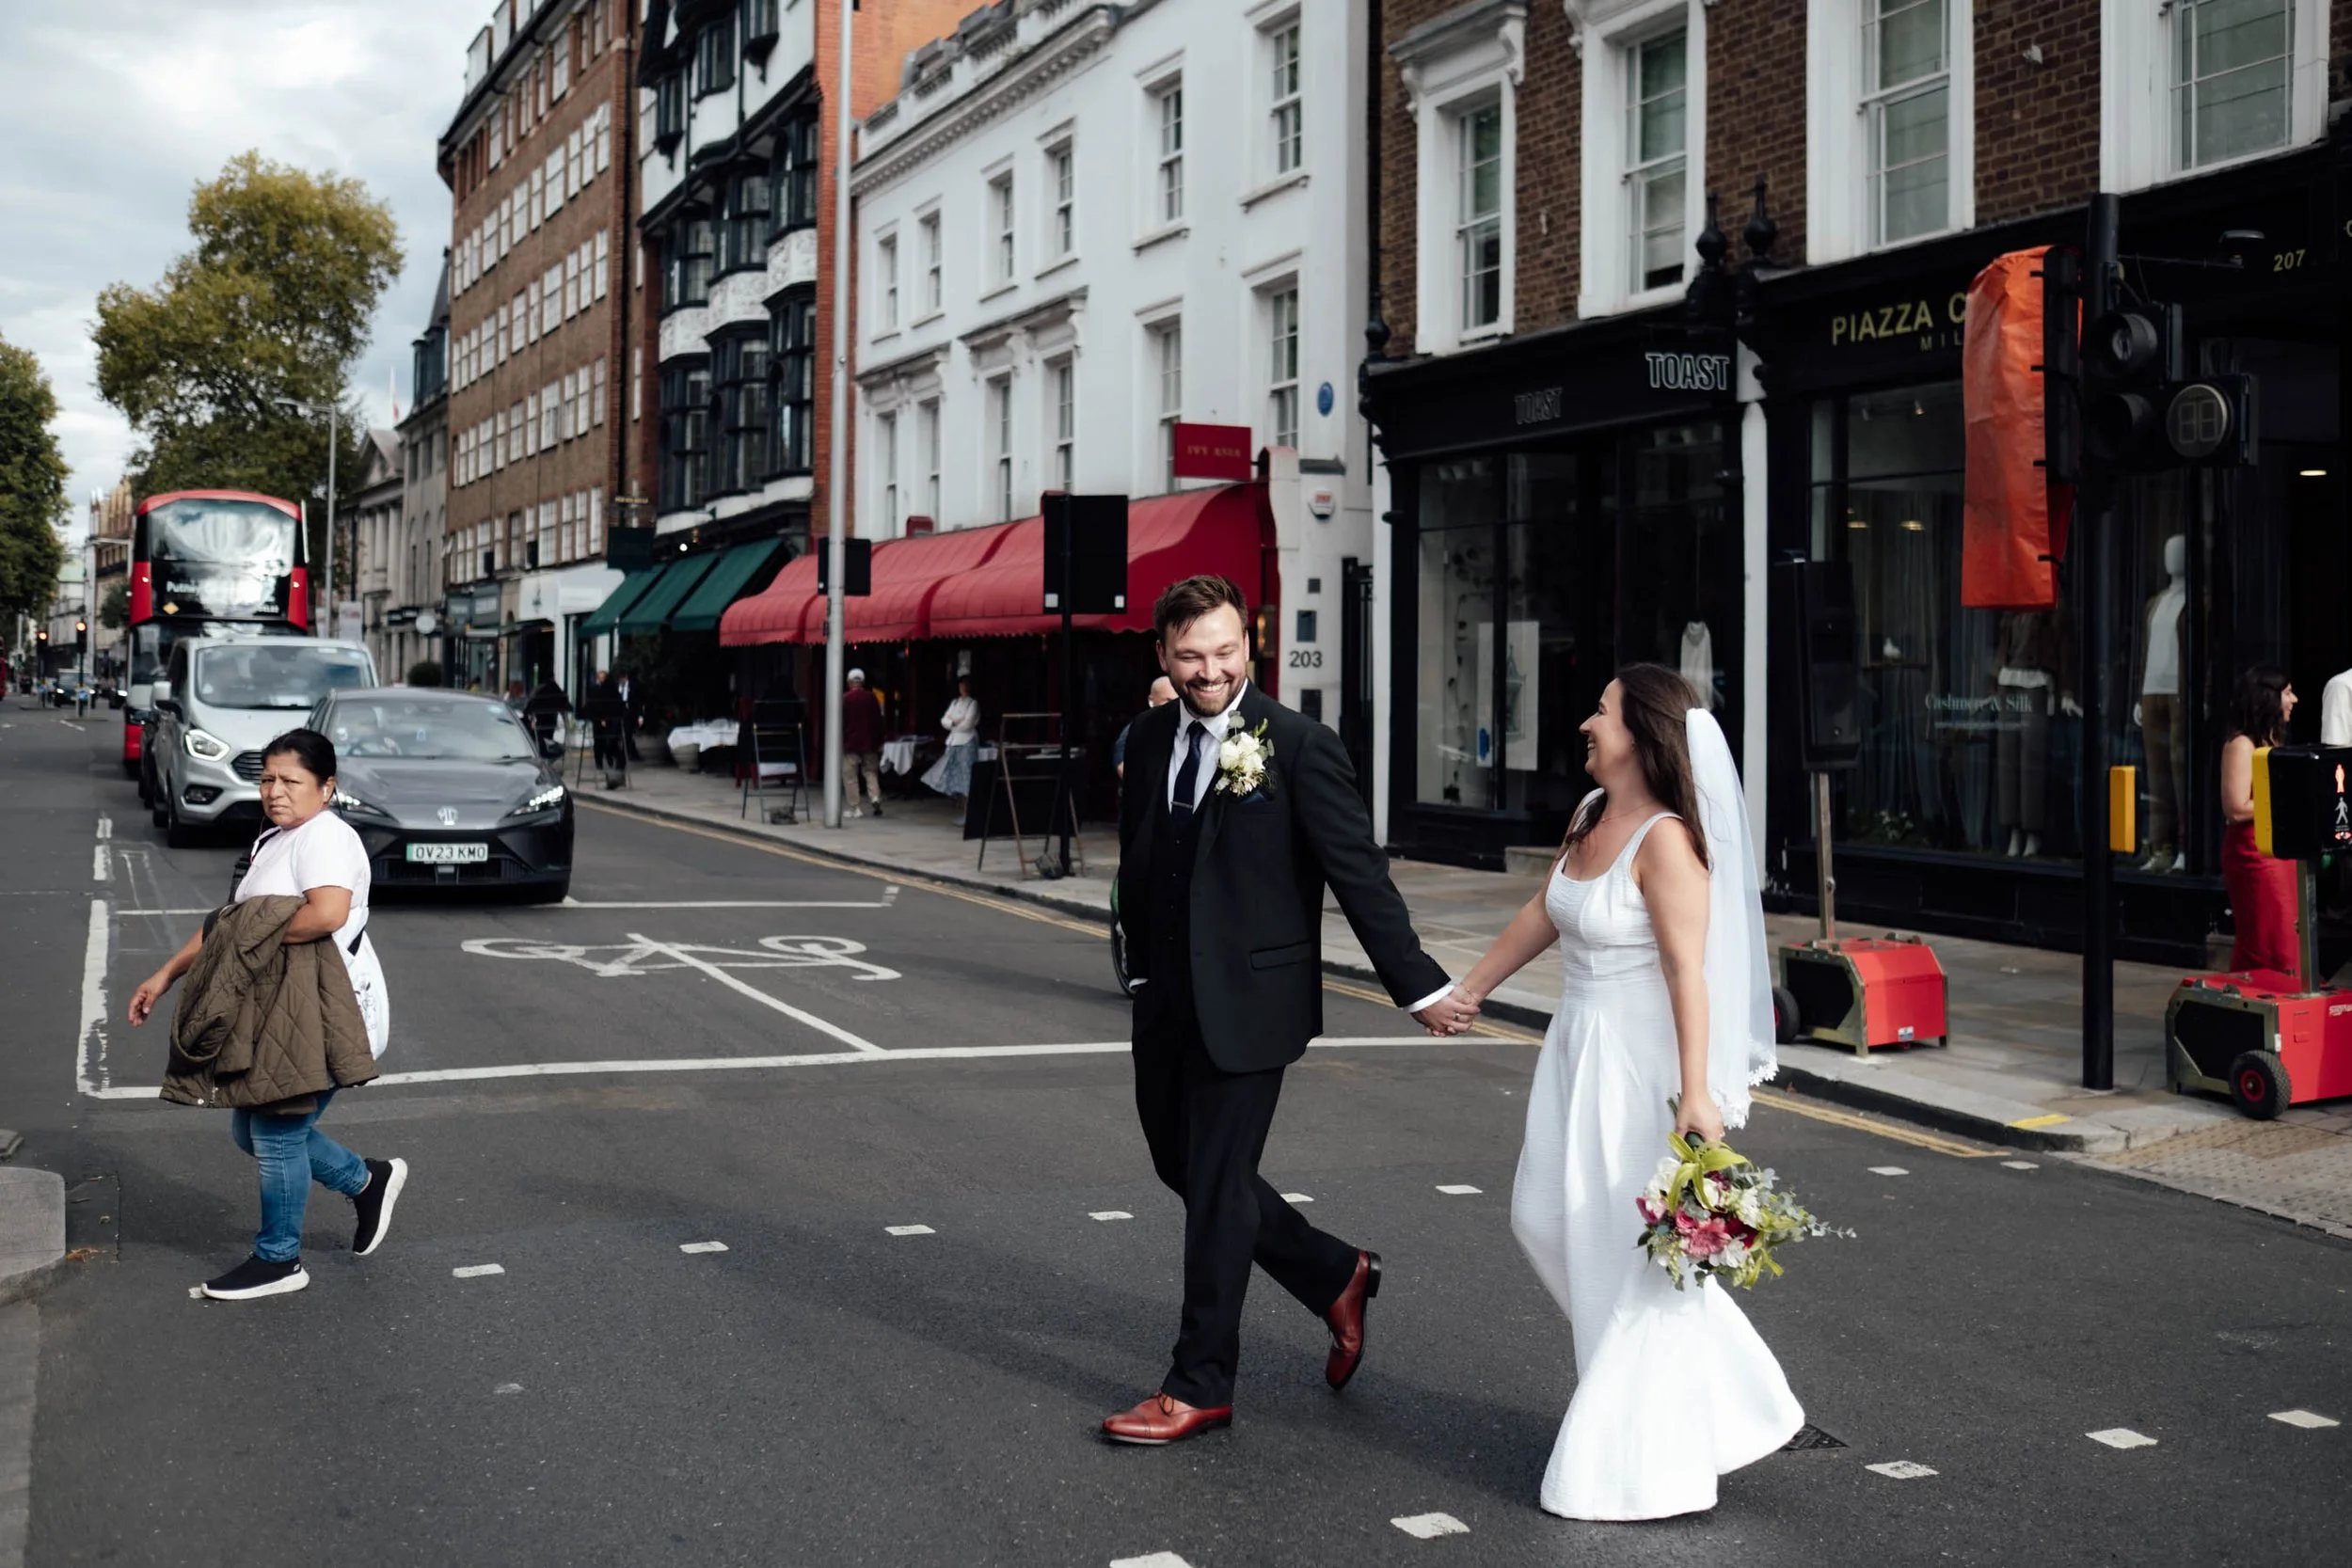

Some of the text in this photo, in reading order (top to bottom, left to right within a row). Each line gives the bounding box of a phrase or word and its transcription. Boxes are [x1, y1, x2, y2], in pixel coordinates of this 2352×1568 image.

[2273, 248, 2305, 272] 207
[1832, 299, 1933, 346] PIAZZA
[1920, 331, 1964, 352] MIL
[1645, 352, 1729, 390] TOAST
[1514, 387, 1563, 425] TOAST
[1289, 650, 1323, 669] 203
[2006, 693, 2032, 712] Silk
[416, 847, 485, 859] OV23 KMO
